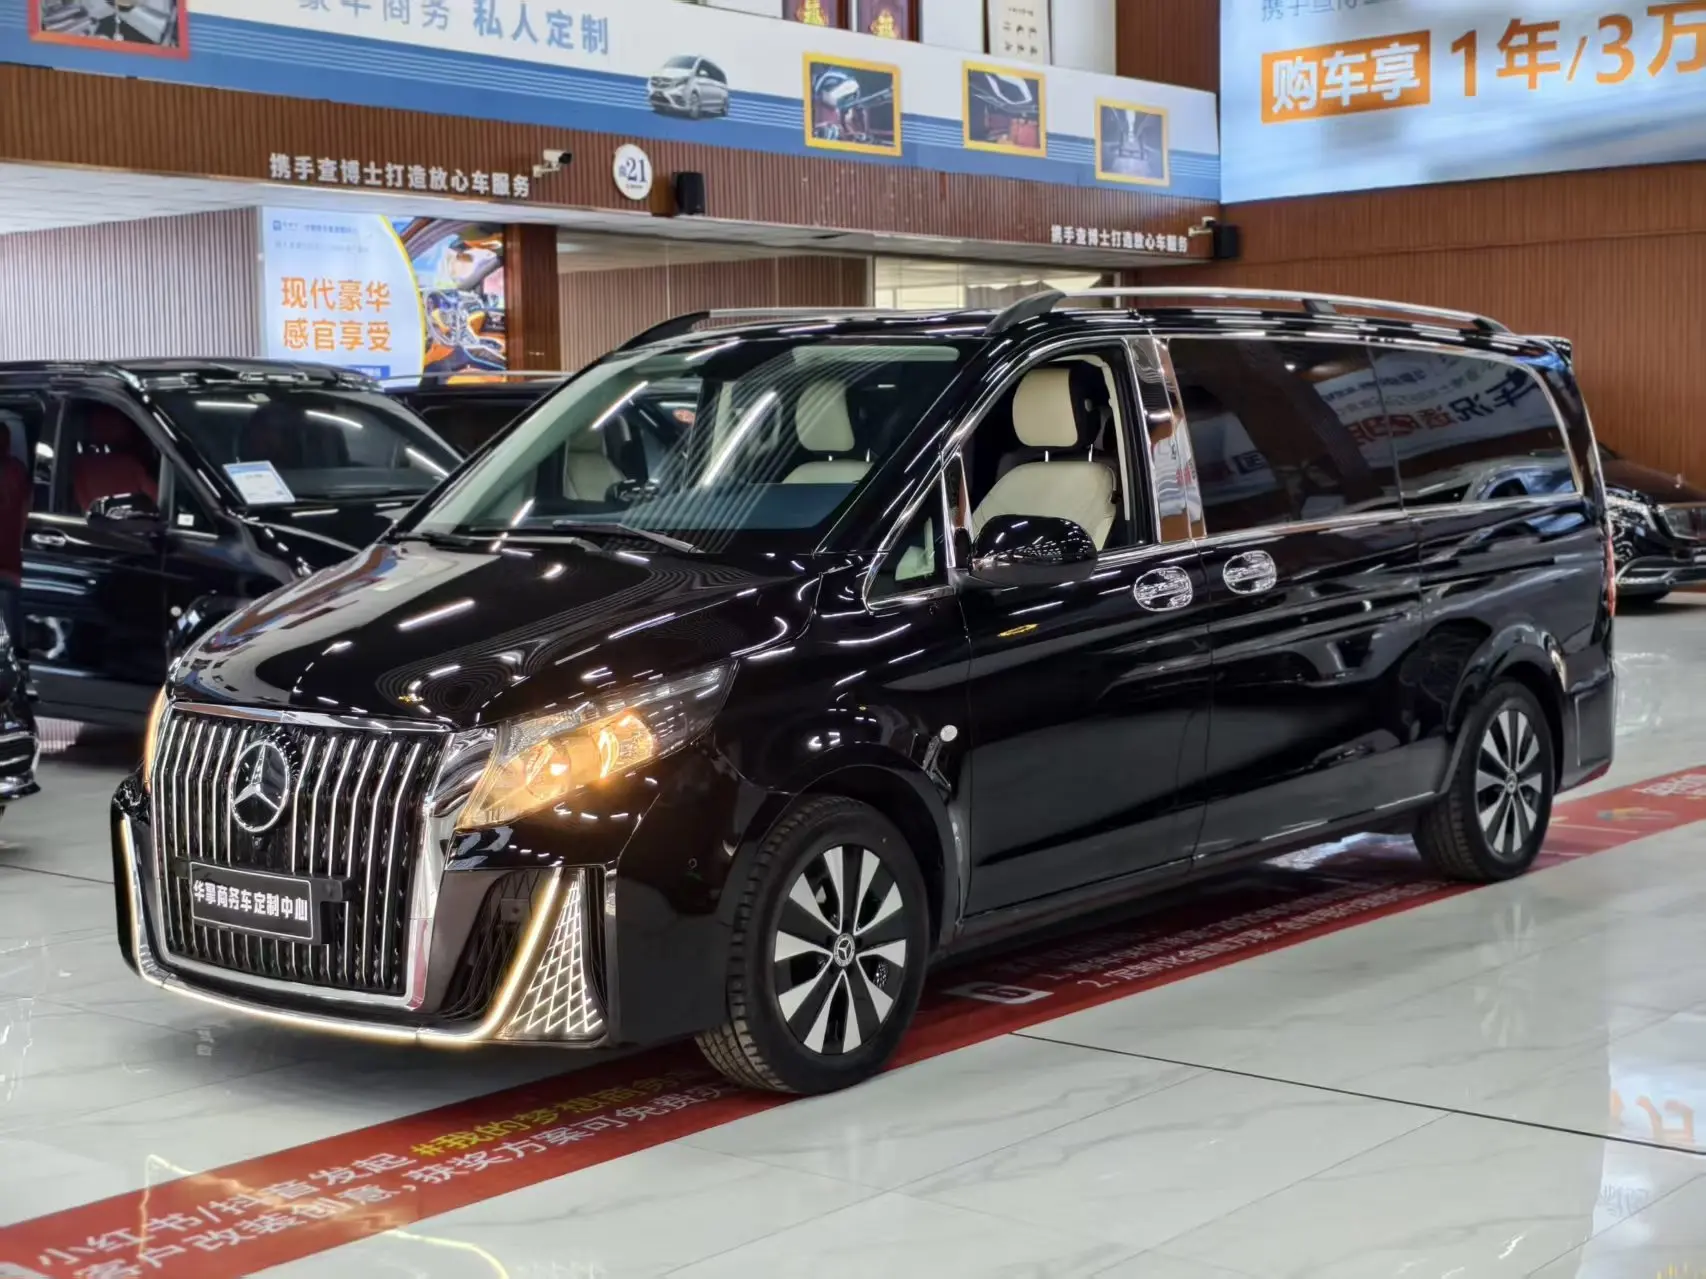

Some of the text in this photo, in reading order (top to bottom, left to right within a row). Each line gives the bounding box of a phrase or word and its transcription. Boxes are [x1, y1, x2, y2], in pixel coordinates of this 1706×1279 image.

[472, 0, 609, 55] 私人定制
[1271, 42, 1421, 114] 购车享
[269, 153, 530, 198] 携手查博士打造放心车服务
[281, 276, 392, 313] 现代豪华
[283, 317, 392, 352] 感官享受
[38, 1152, 416, 1266] 小红书/抖音发起
